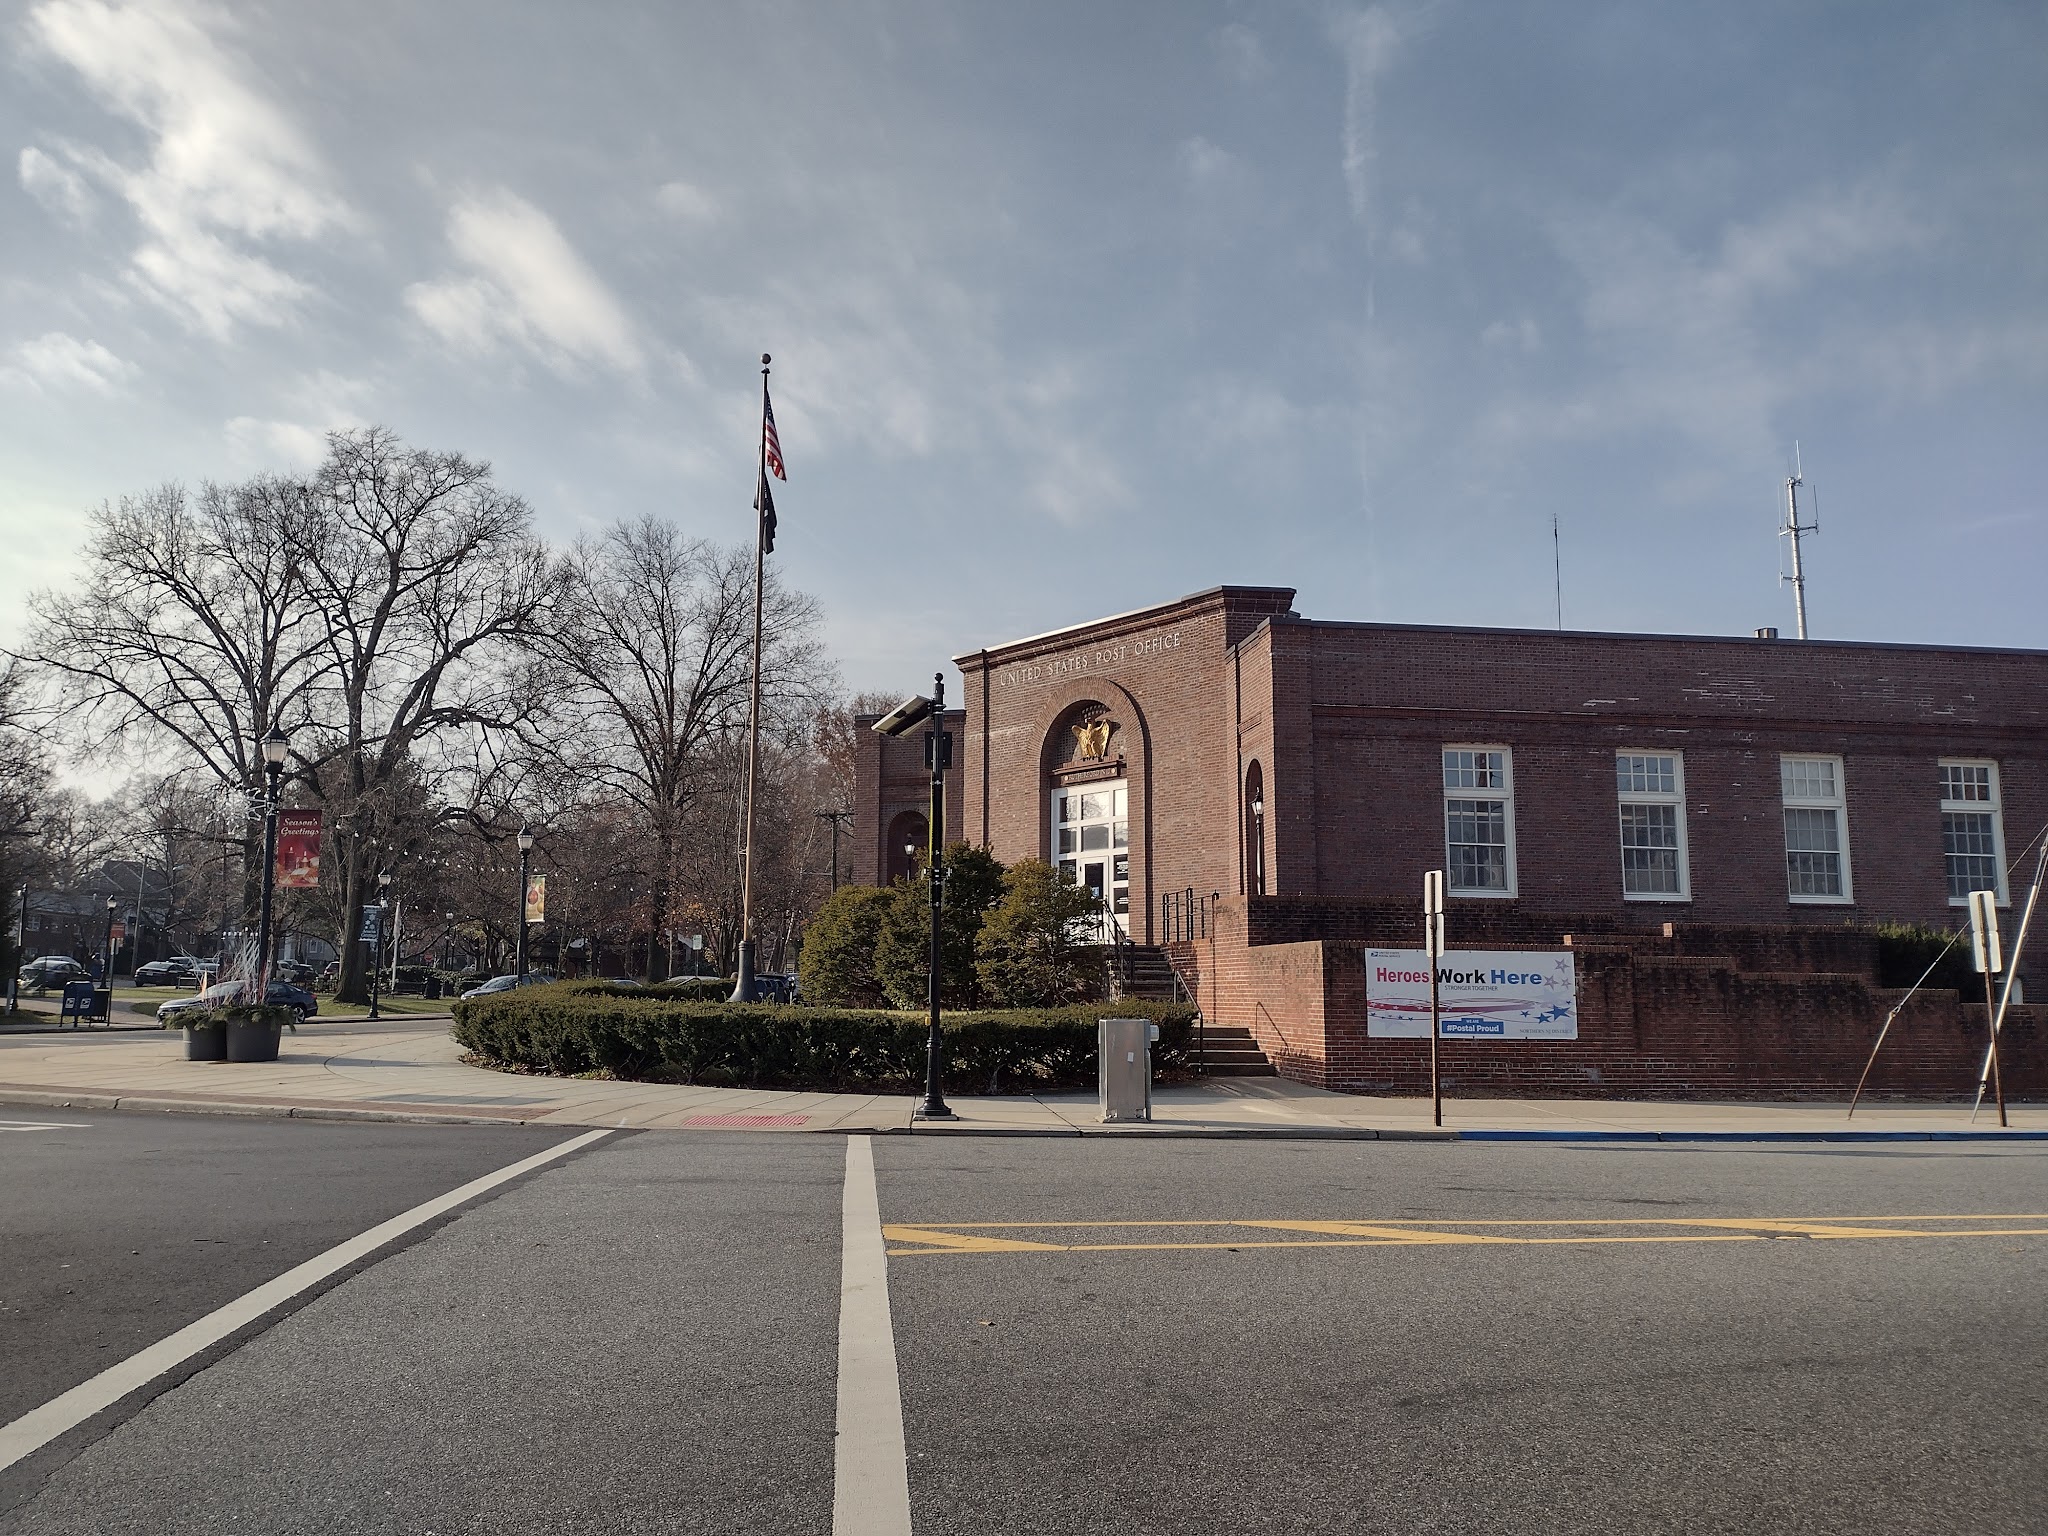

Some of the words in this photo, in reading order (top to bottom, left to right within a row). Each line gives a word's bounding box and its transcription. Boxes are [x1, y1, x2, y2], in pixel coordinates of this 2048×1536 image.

[1000, 666, 1041, 685] UNITED
[1048, 655, 1088, 676] STATES
[1095, 645, 1127, 665] POST
[1134, 632, 1180, 655] OFFICE
[283, 817, 318, 827] Season's
[280, 827, 320, 838] Greetings
[1376, 967, 1430, 983] Heroes
[1436, 968, 1486, 984] Work
[1490, 969, 1542, 985] Here
[1446, 1024, 1475, 1032] #Postal
[1476, 1024, 1500, 1032] Proud
